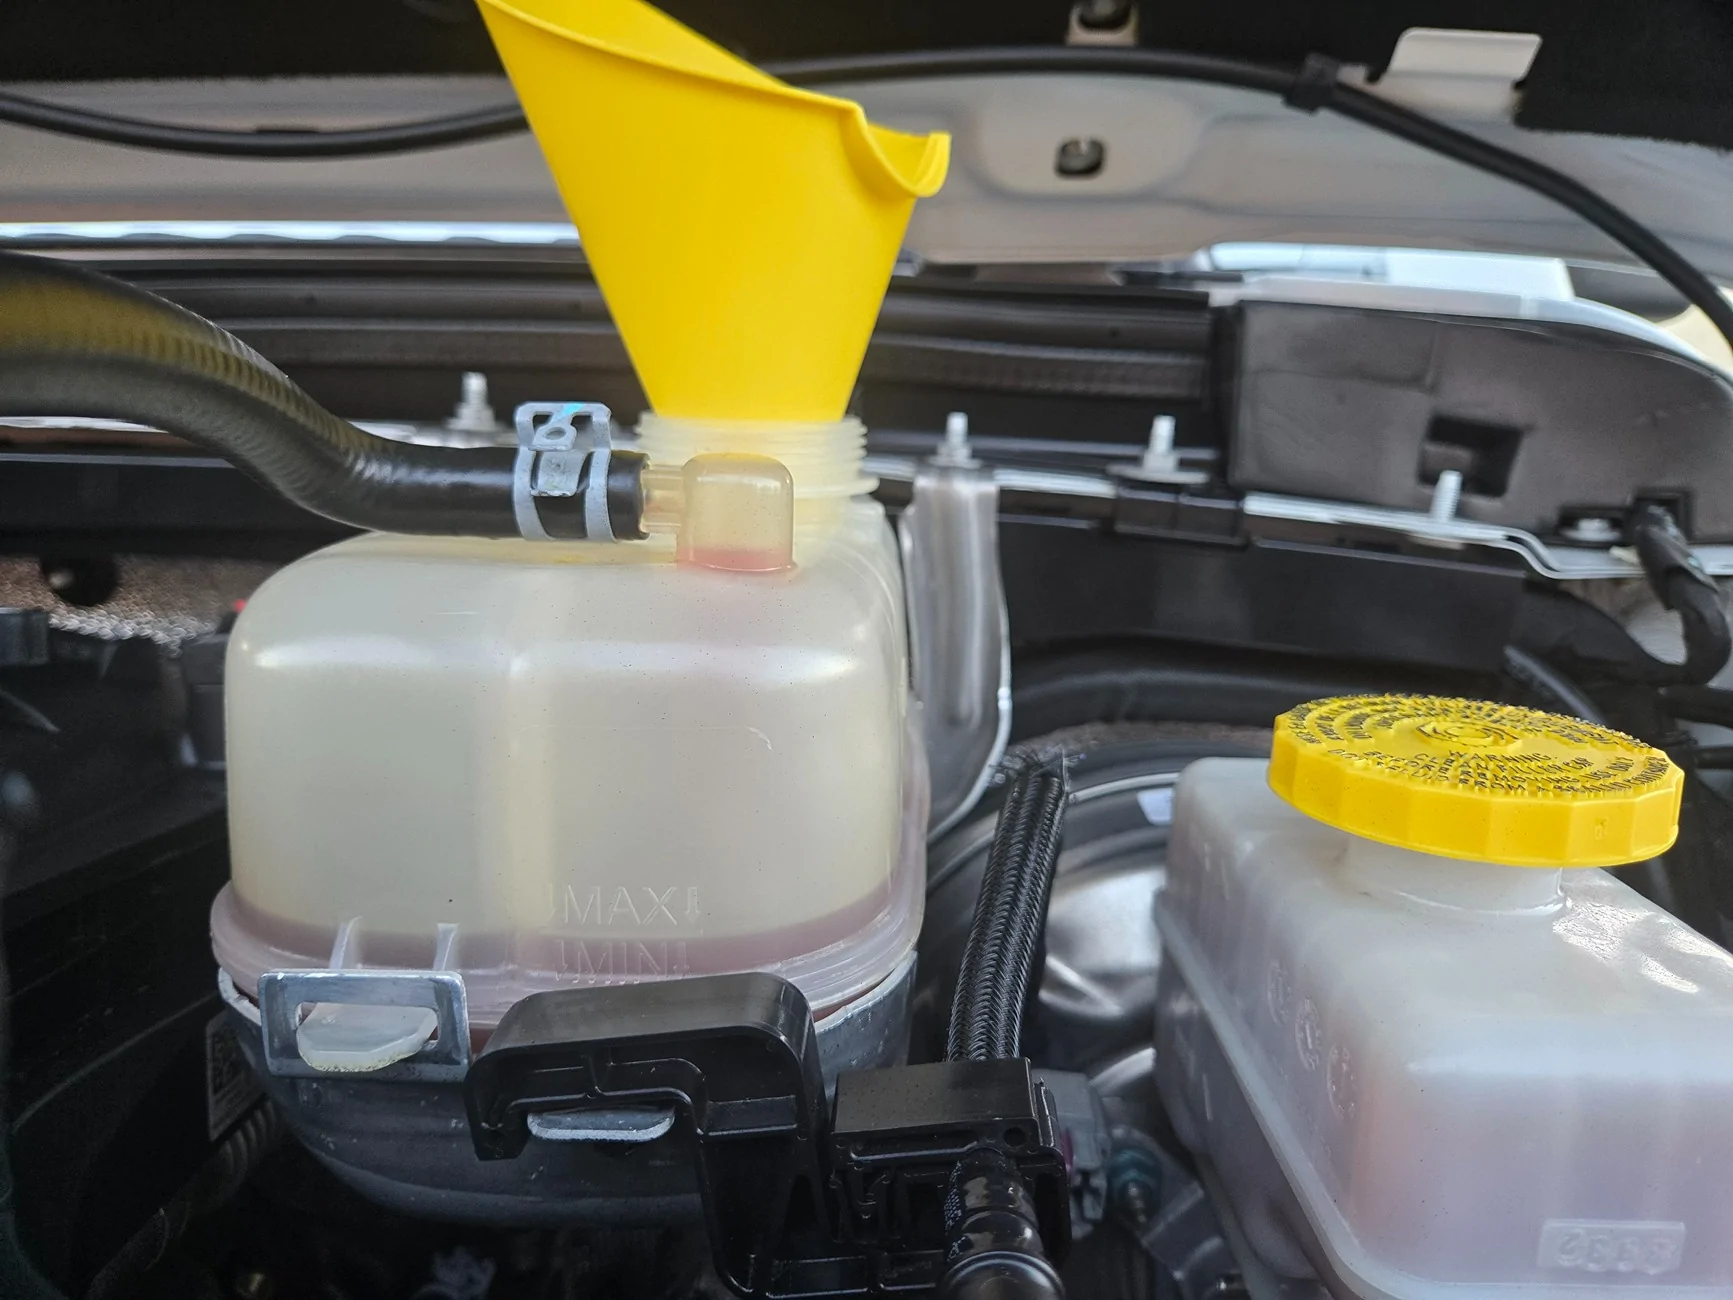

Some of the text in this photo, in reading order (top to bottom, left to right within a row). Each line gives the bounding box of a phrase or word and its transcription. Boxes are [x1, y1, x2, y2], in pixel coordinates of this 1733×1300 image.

[1363, 751, 1450, 775] BEFORE
[1414, 753, 1489, 772] CLEAN
[563, 884, 677, 926] MAX
[577, 939, 668, 979] MIN
